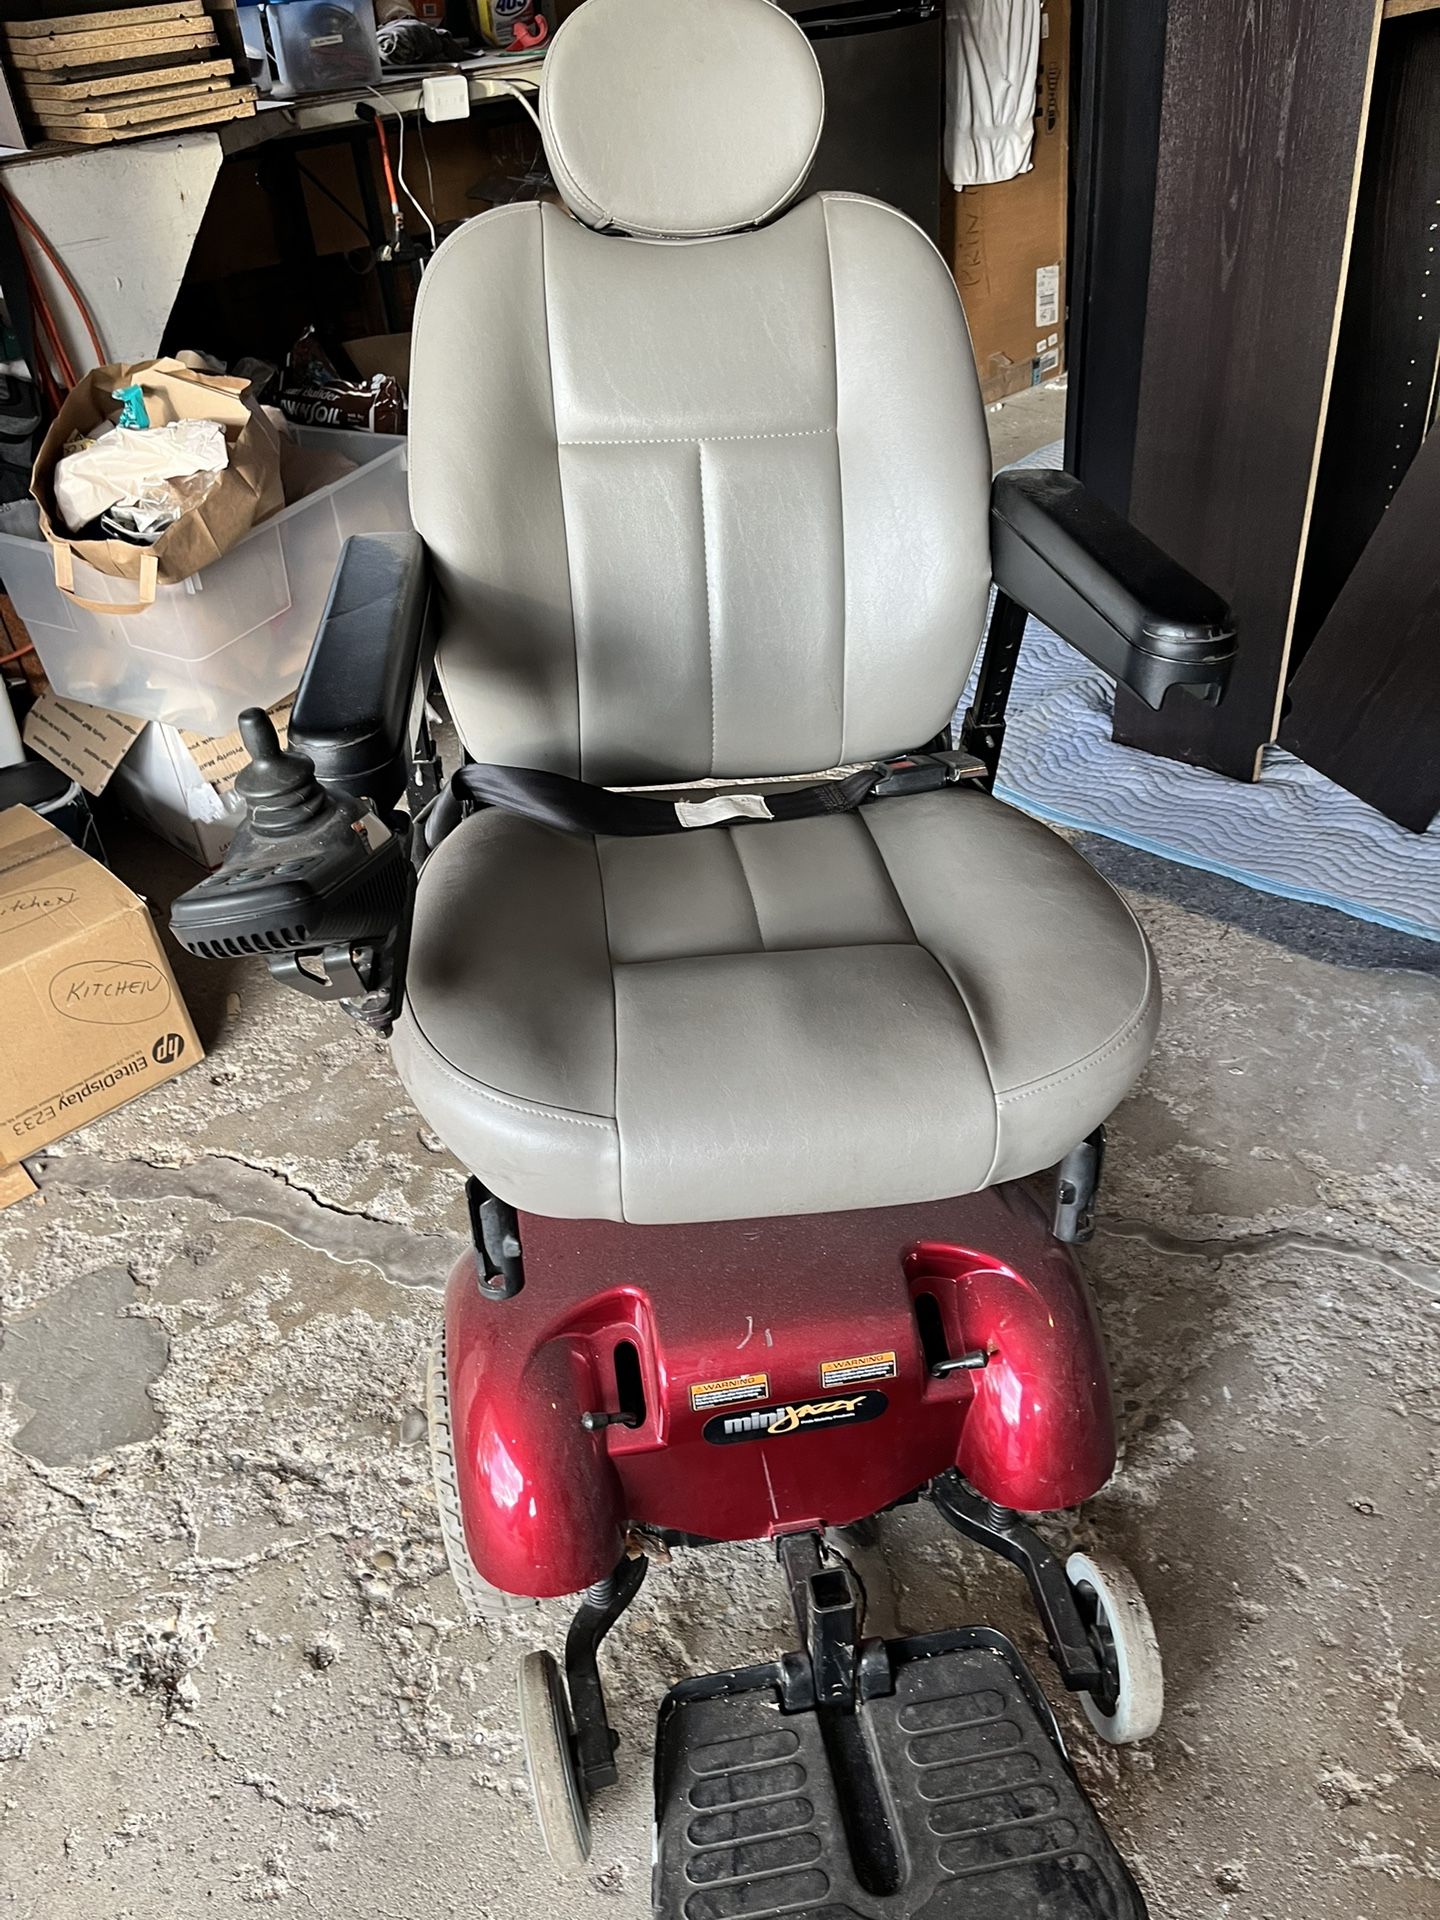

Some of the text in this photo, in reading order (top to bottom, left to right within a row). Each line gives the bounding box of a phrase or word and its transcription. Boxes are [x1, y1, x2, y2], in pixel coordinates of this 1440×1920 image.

[216, 746, 244, 762] Priority
[66, 976, 162, 1002] KITCHEN
[152, 1033, 185, 1064] hp
[58, 1056, 148, 1111] EliteDisplay
[12, 1105, 57, 1137] E233
[833, 1355, 884, 1369] WARNING
[703, 1377, 755, 1391] WARNING
[724, 1407, 785, 1434] mini
